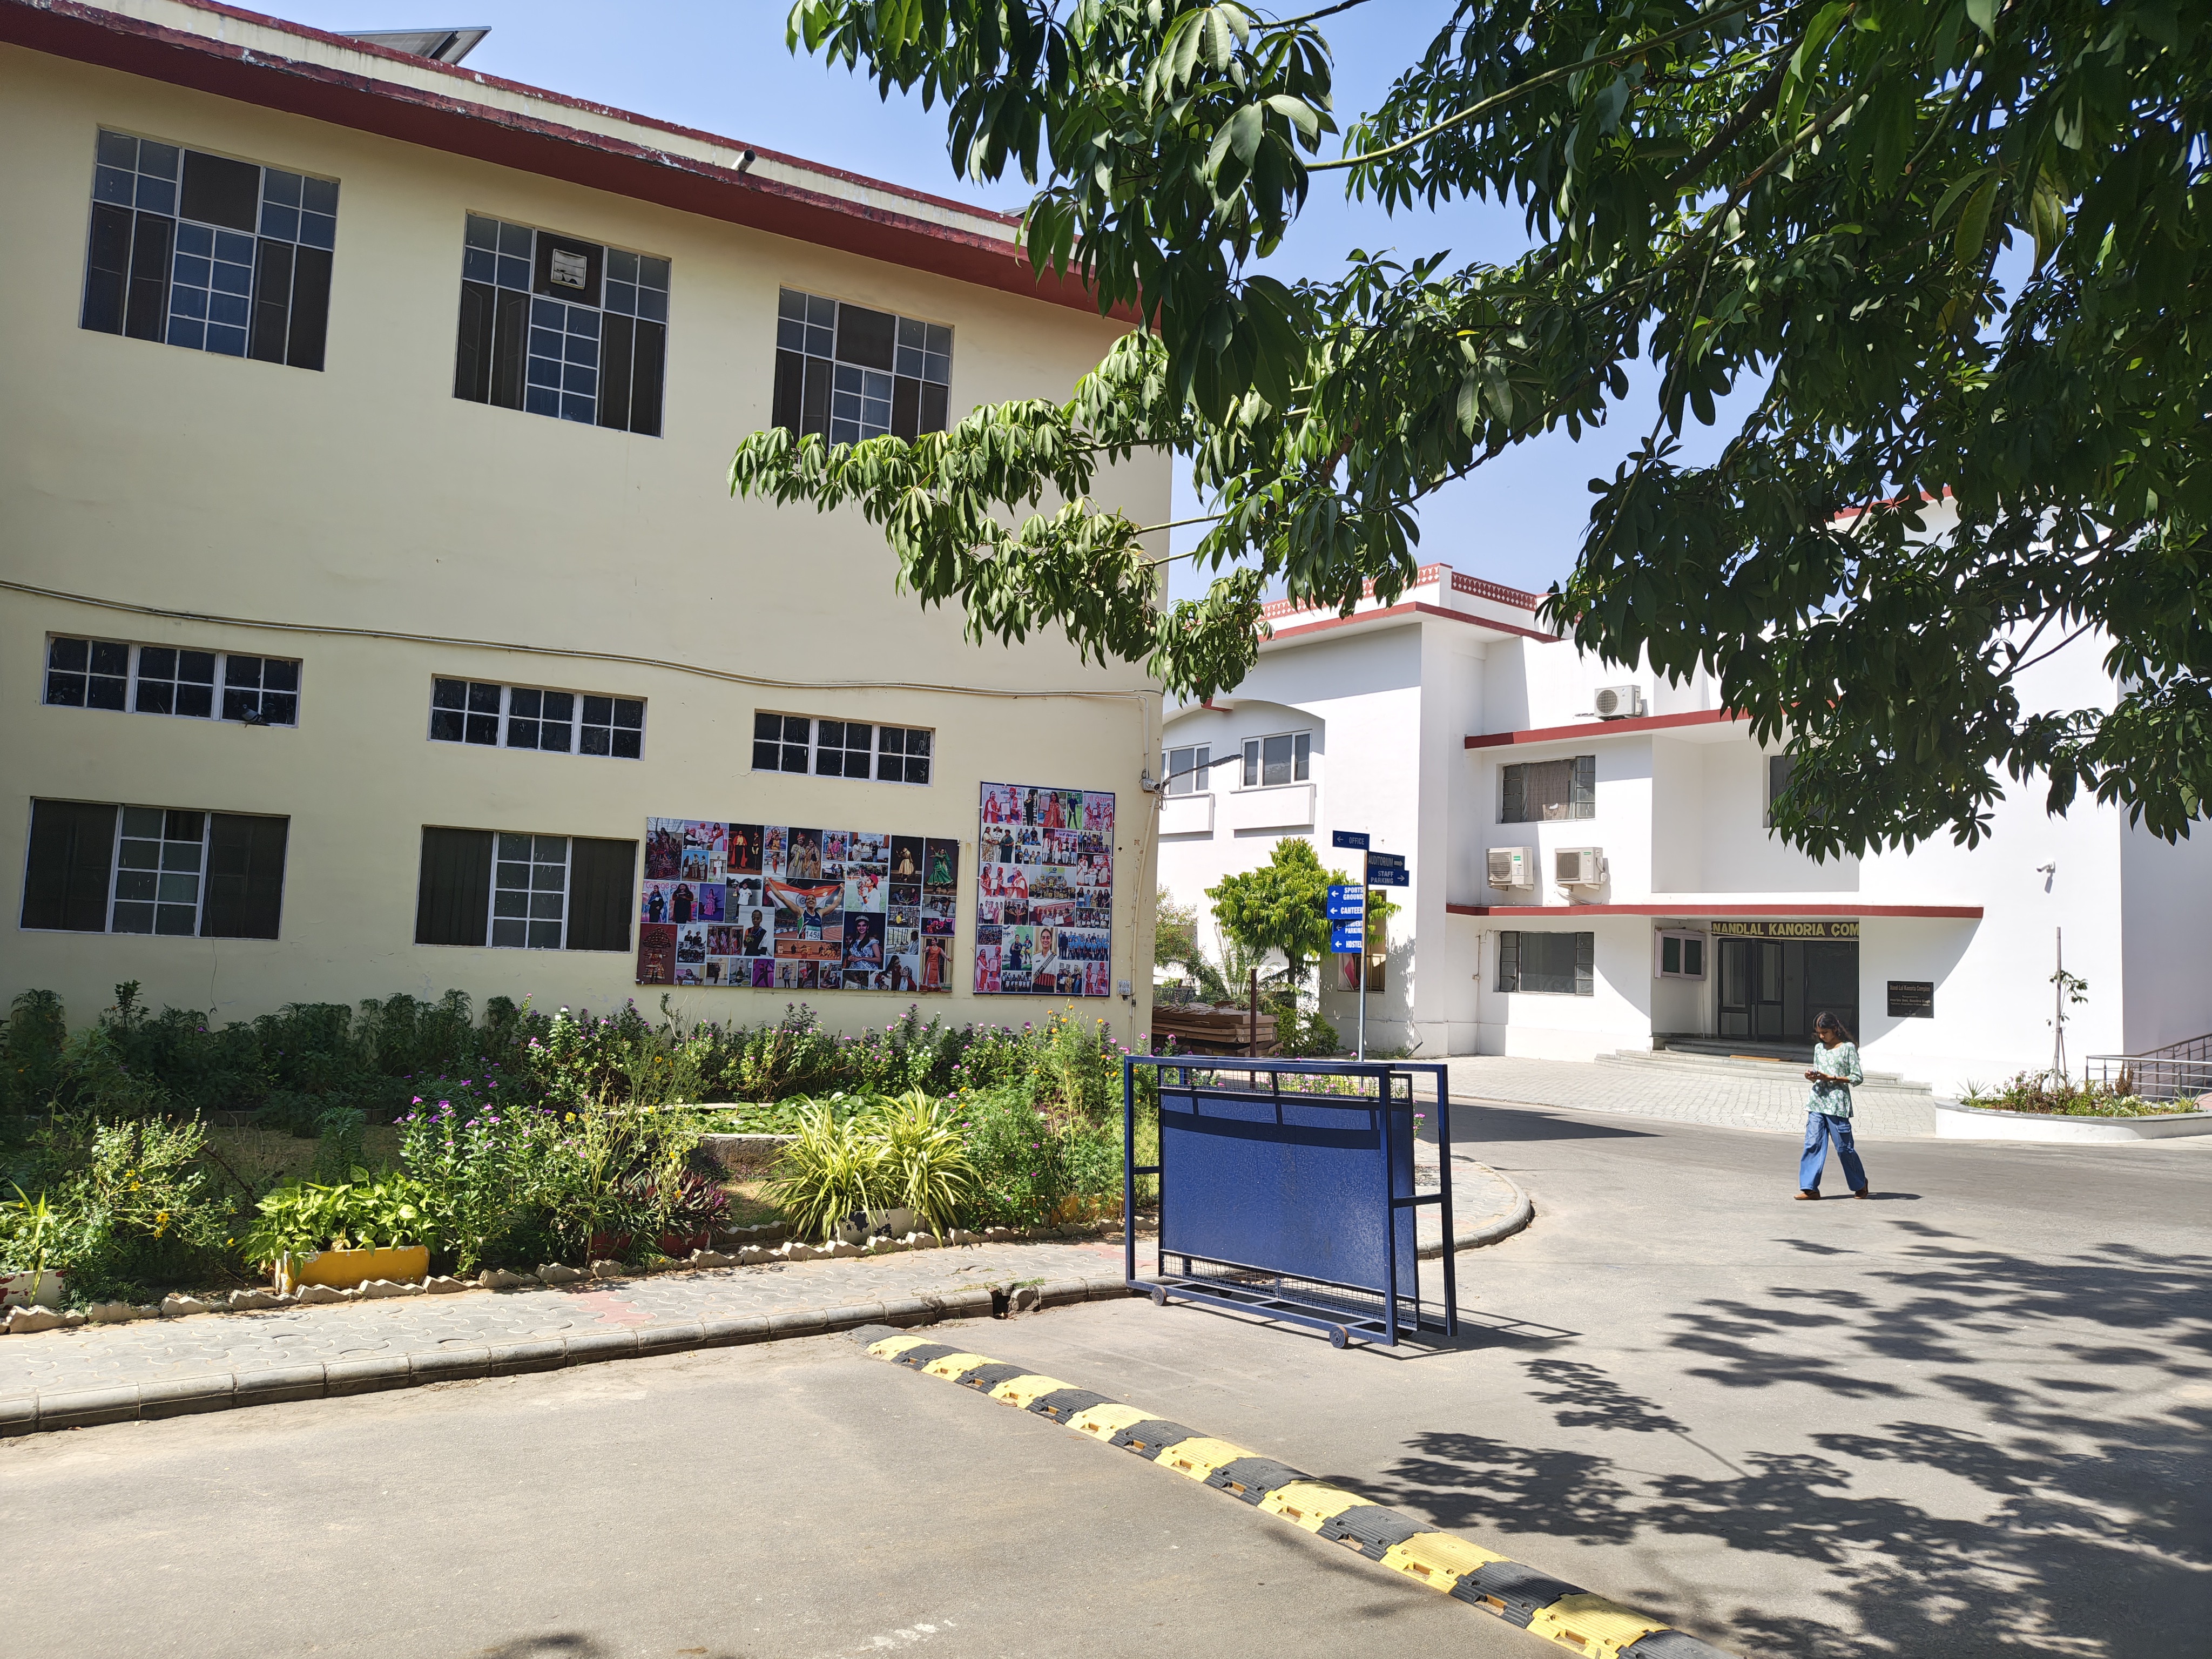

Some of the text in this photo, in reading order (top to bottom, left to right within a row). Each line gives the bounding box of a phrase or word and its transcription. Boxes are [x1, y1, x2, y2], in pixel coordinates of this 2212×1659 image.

[1348, 837, 1365, 845] OFFICE
[1368, 855, 1393, 867] AUDITORIUM
[806, 930, 820, 939] 1458
[1712, 923, 1764, 935] NANDLAL
[1769, 923, 1825, 936] KANORIA
